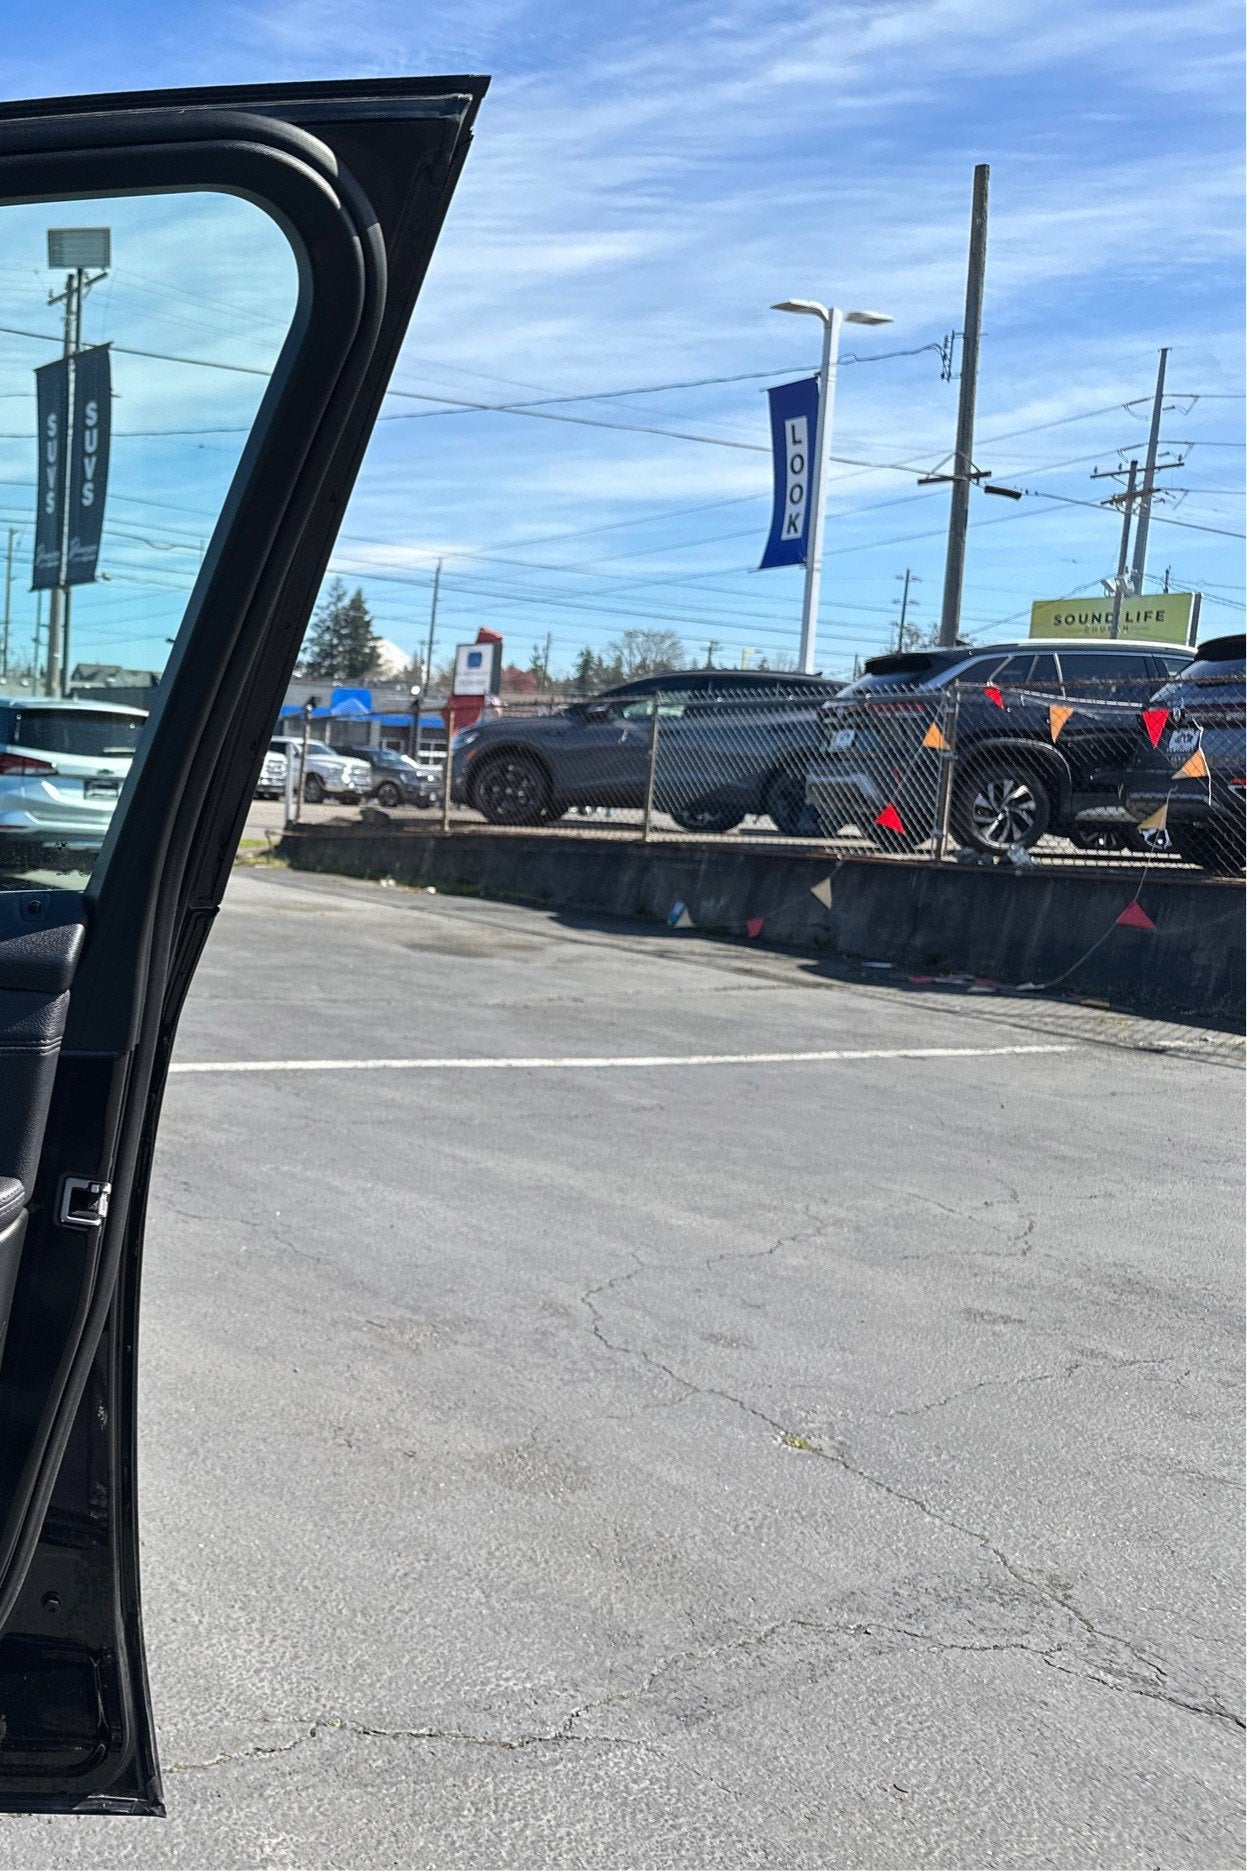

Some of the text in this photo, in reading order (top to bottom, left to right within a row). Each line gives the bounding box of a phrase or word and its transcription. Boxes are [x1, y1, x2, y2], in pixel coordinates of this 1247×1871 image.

[46, 413, 58, 514] SUVS
[81, 401, 98, 507] SUVS
[786, 424, 805, 535] LOOK
[1083, 625, 1129, 634] CHURH
[1125, 609, 1166, 623] LIFE
